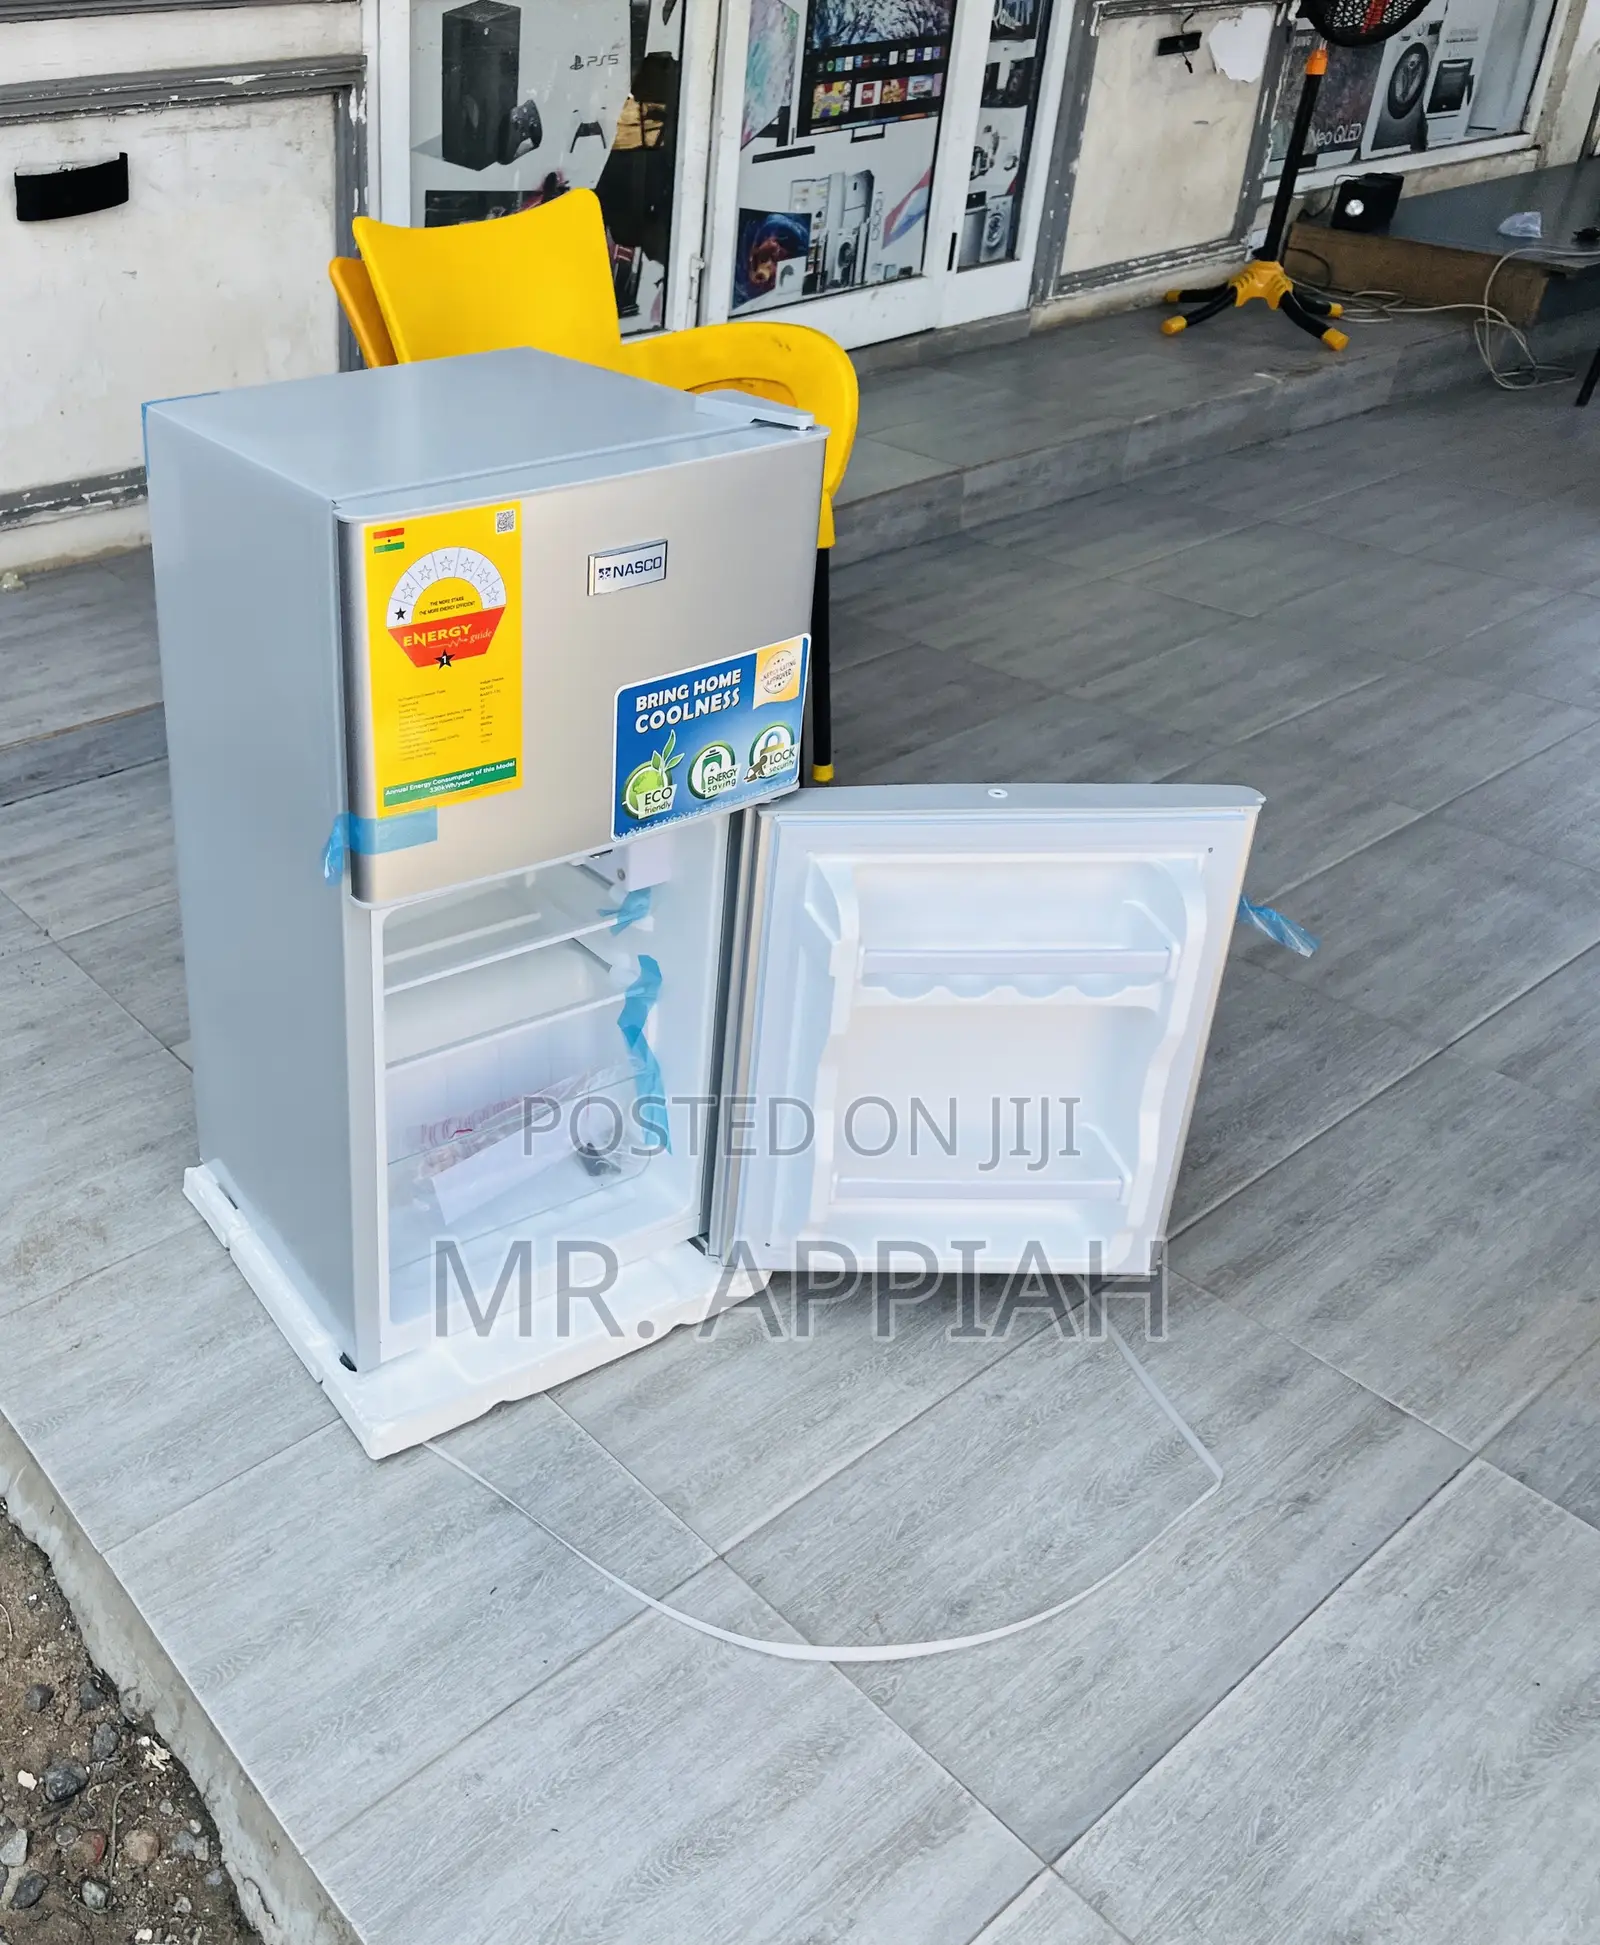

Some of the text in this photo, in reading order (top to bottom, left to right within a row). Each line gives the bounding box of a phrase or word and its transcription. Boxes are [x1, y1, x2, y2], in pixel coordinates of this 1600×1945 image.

[587, 54, 619, 67] PS5
[1334, 123, 1362, 144] QLED
[613, 556, 662, 578] NASCO
[403, 623, 472, 647] ENERGY
[470, 628, 493, 644] guide
[441, 655, 447, 664] 1
[635, 668, 742, 713] BRING HOME
[635, 687, 740, 734] COOLNESS
[769, 747, 795, 765] LOCK
[769, 759, 795, 774] security
[385, 760, 516, 796] Annual Energy Consumption of this Model
[707, 767, 738, 785] ENERGY
[707, 777, 737, 794] saving
[644, 786, 673, 806] ECO
[644, 801, 672, 814] friendly
